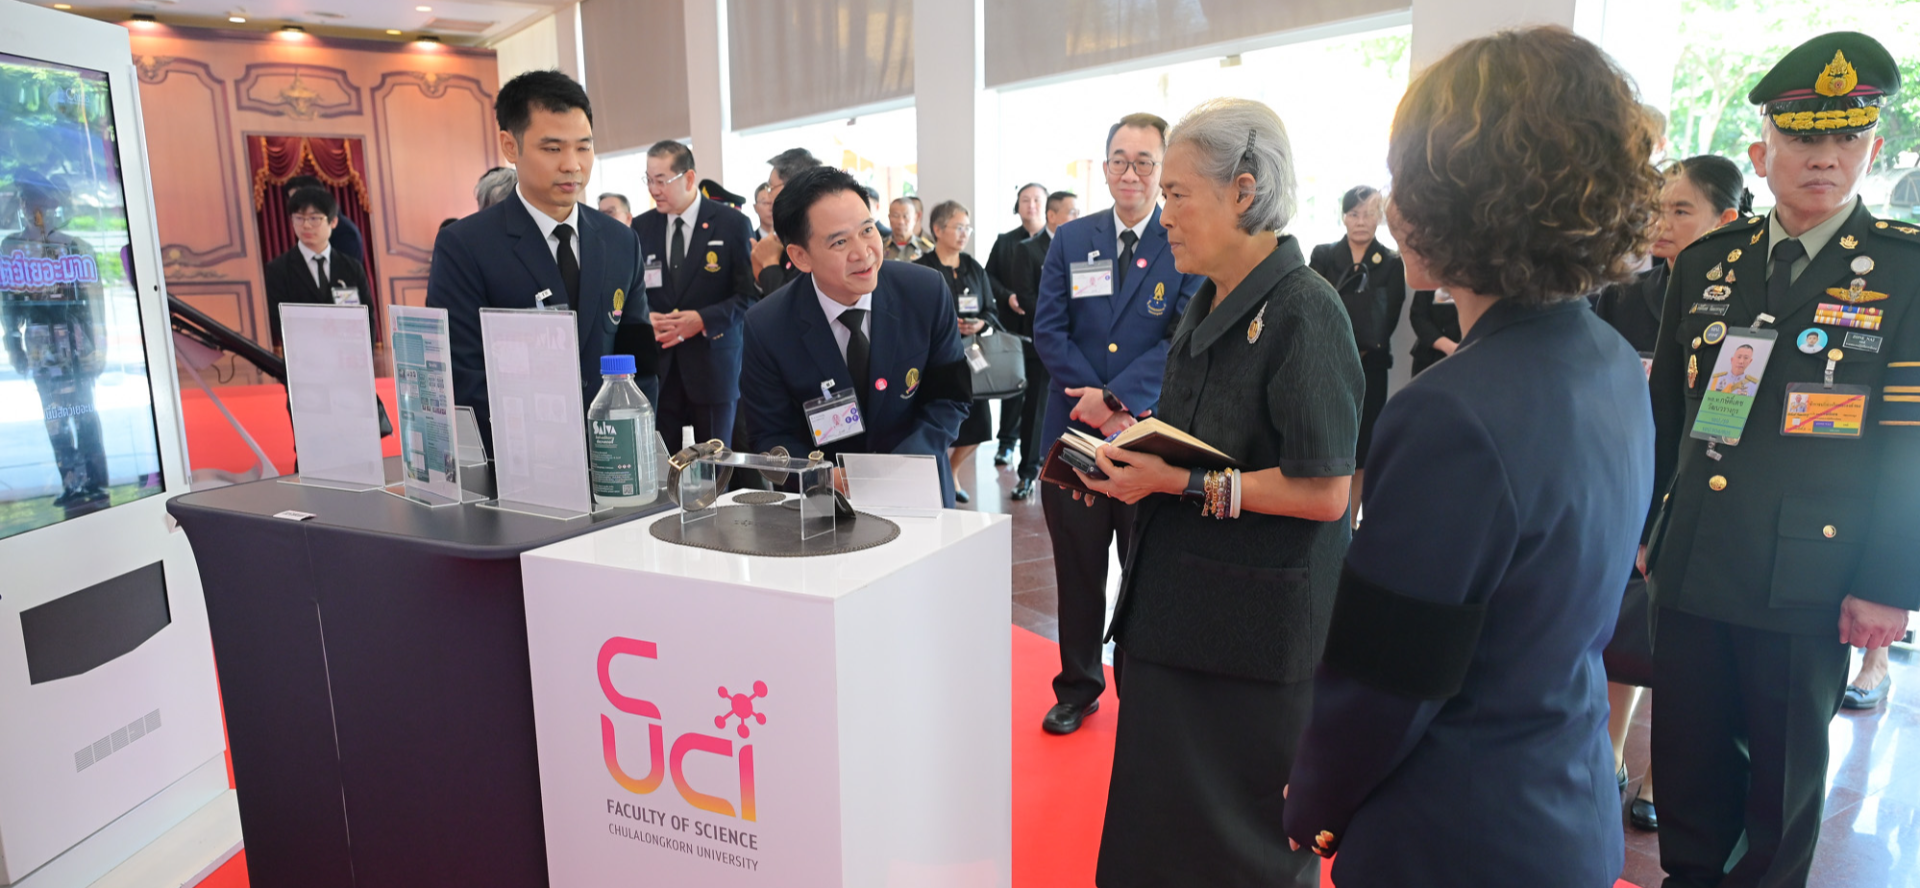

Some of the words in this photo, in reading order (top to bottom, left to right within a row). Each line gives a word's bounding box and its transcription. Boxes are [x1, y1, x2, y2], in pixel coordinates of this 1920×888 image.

[0, 250, 97, 287] ตว์เยอะมาก
[607, 798, 666, 827] FACULTY
[670, 815, 690, 832] OF
[695, 820, 758, 850] SCIENCE
[608, 823, 693, 855] CHULALONGKORN
[696, 845, 759, 872] UNIVERSITY
